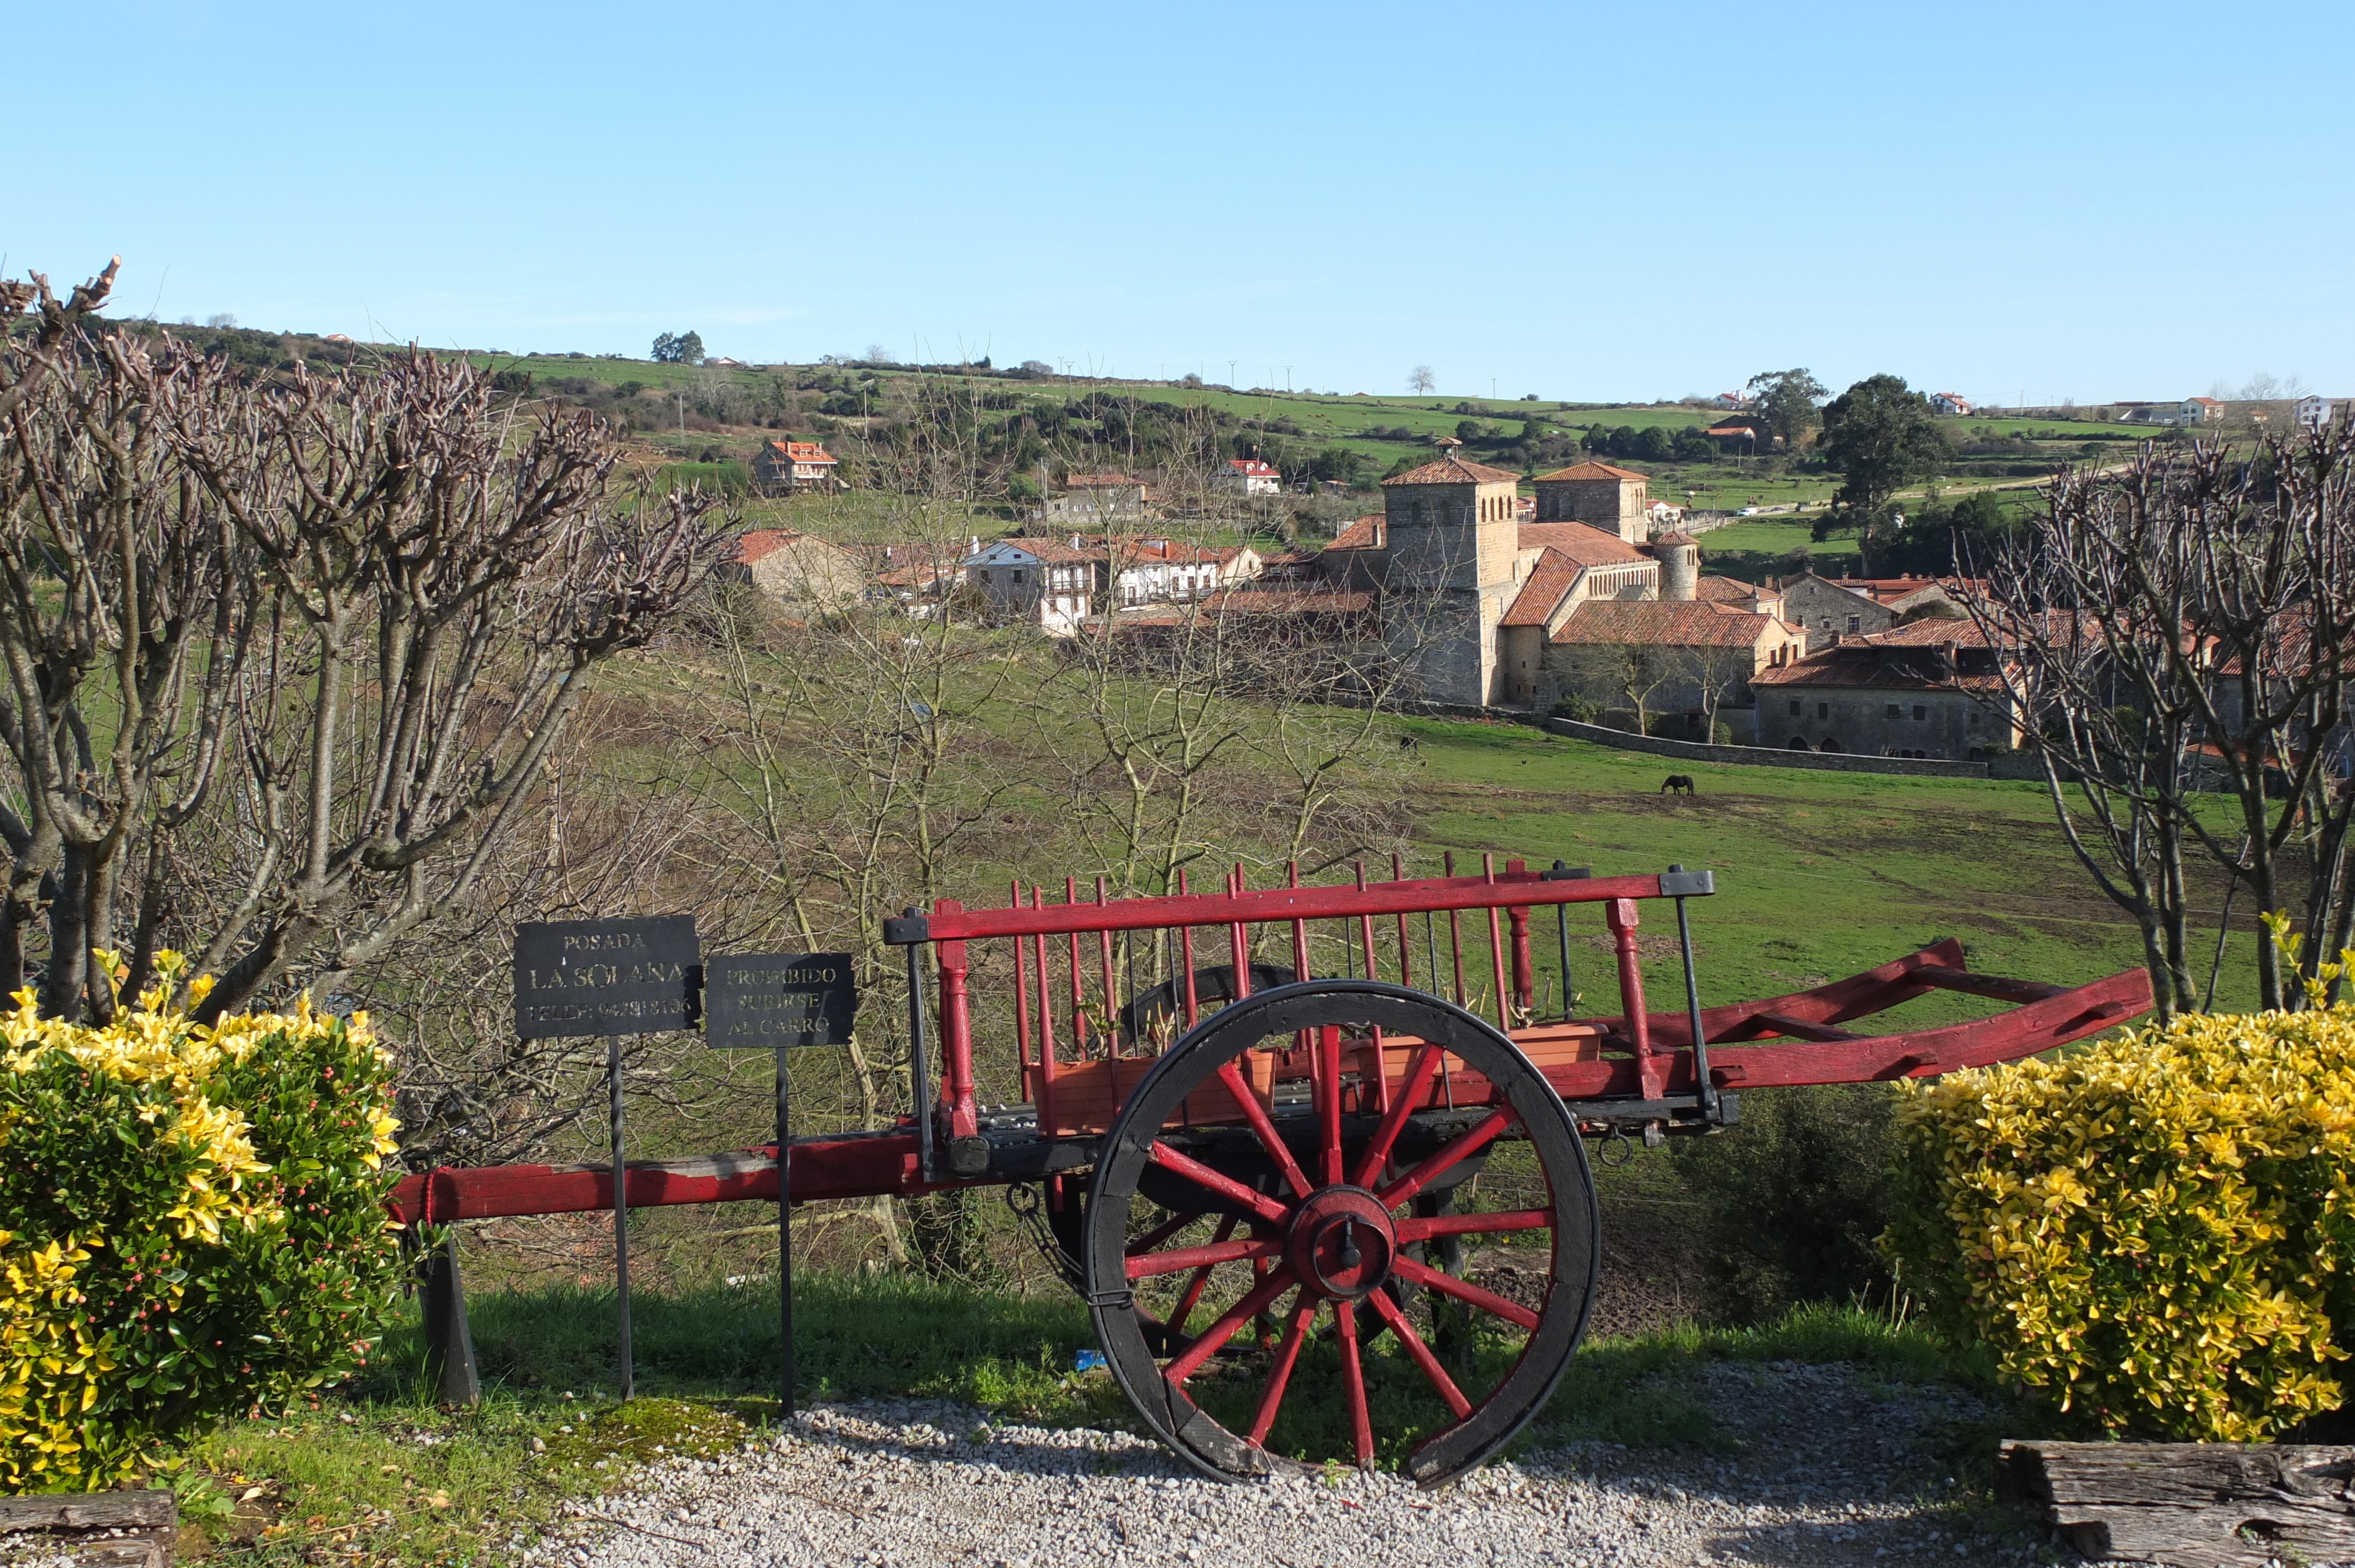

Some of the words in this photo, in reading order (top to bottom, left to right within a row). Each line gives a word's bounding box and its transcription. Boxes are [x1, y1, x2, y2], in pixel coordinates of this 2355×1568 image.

[563, 932, 646, 951] POSADA
[529, 968, 566, 989] LA
[573, 962, 685, 988] SOLANA
[727, 968, 837, 985] PROHIBIDO
[737, 992, 820, 1010] SUBIRSE
[525, 1004, 594, 1021] TELEF:
[728, 1019, 756, 1035] AL
[759, 1016, 830, 1035] CARRO
